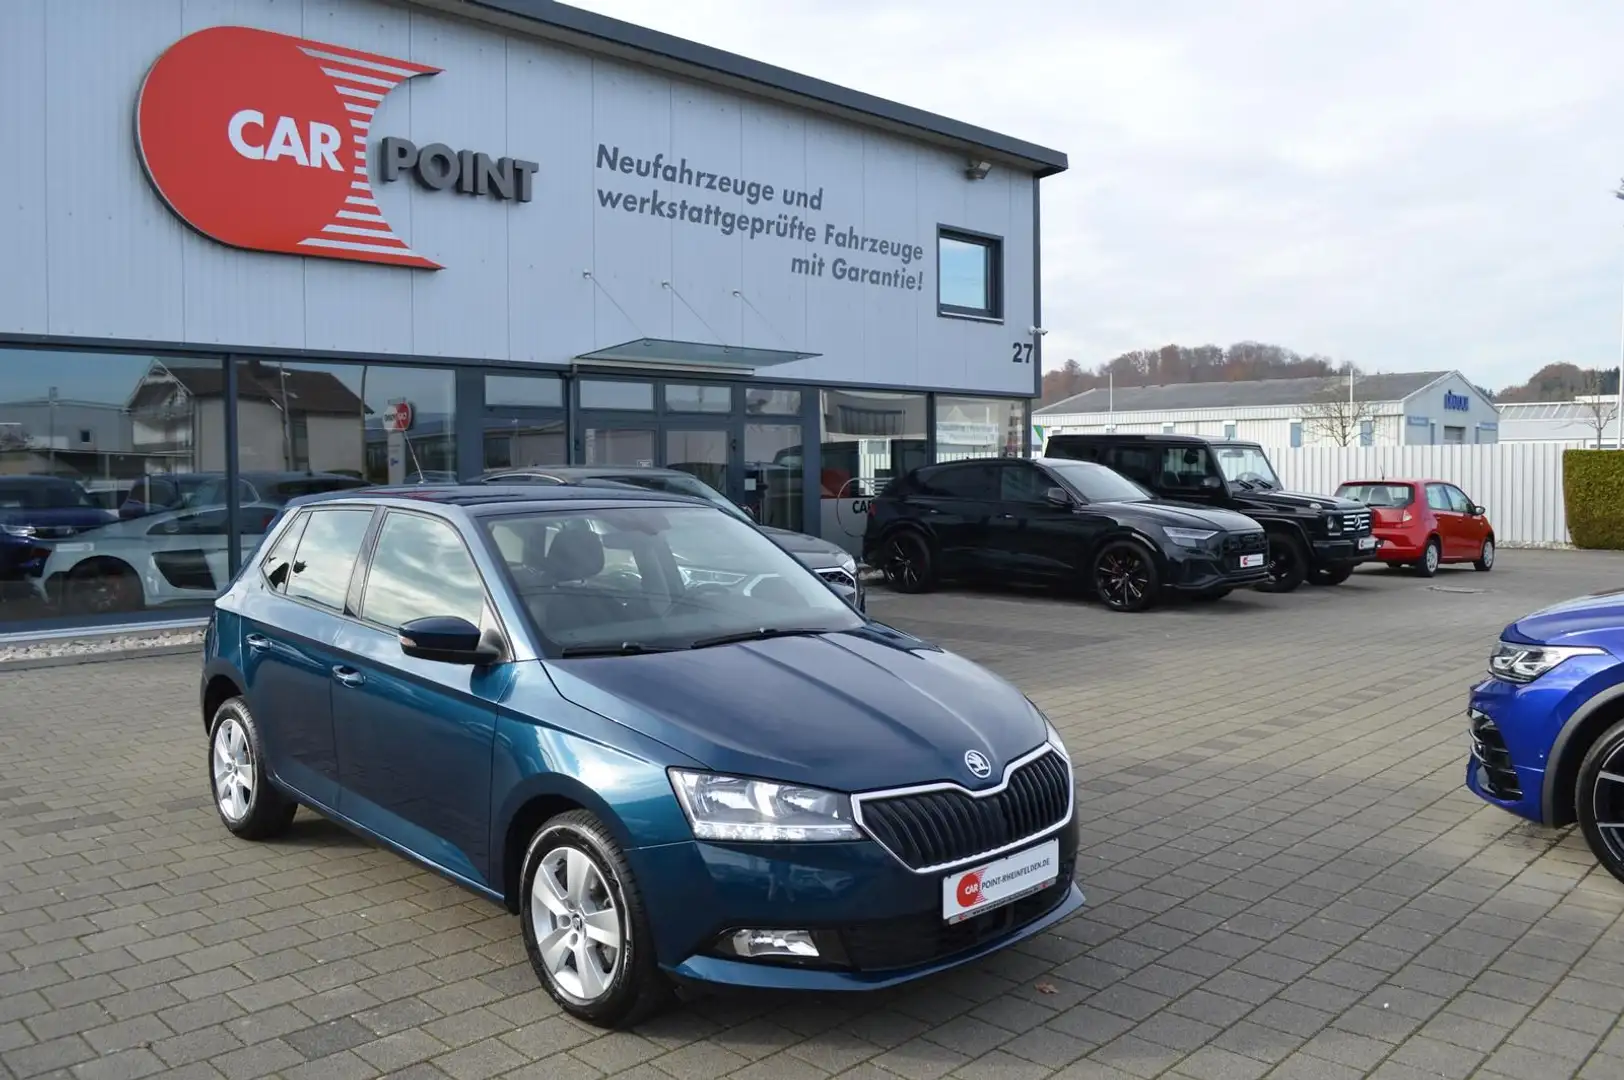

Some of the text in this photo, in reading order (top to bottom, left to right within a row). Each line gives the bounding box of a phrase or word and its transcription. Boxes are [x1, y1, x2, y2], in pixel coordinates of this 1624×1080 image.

[228, 109, 539, 203] CAR POINT
[596, 143, 824, 211] Neufahrzeuge und
[596, 188, 924, 265] werkstattgeprüfte Fahrzeuge
[791, 253, 924, 291] mit Garantie!
[1012, 342, 1033, 363] 27
[964, 883, 979, 895] CAR
